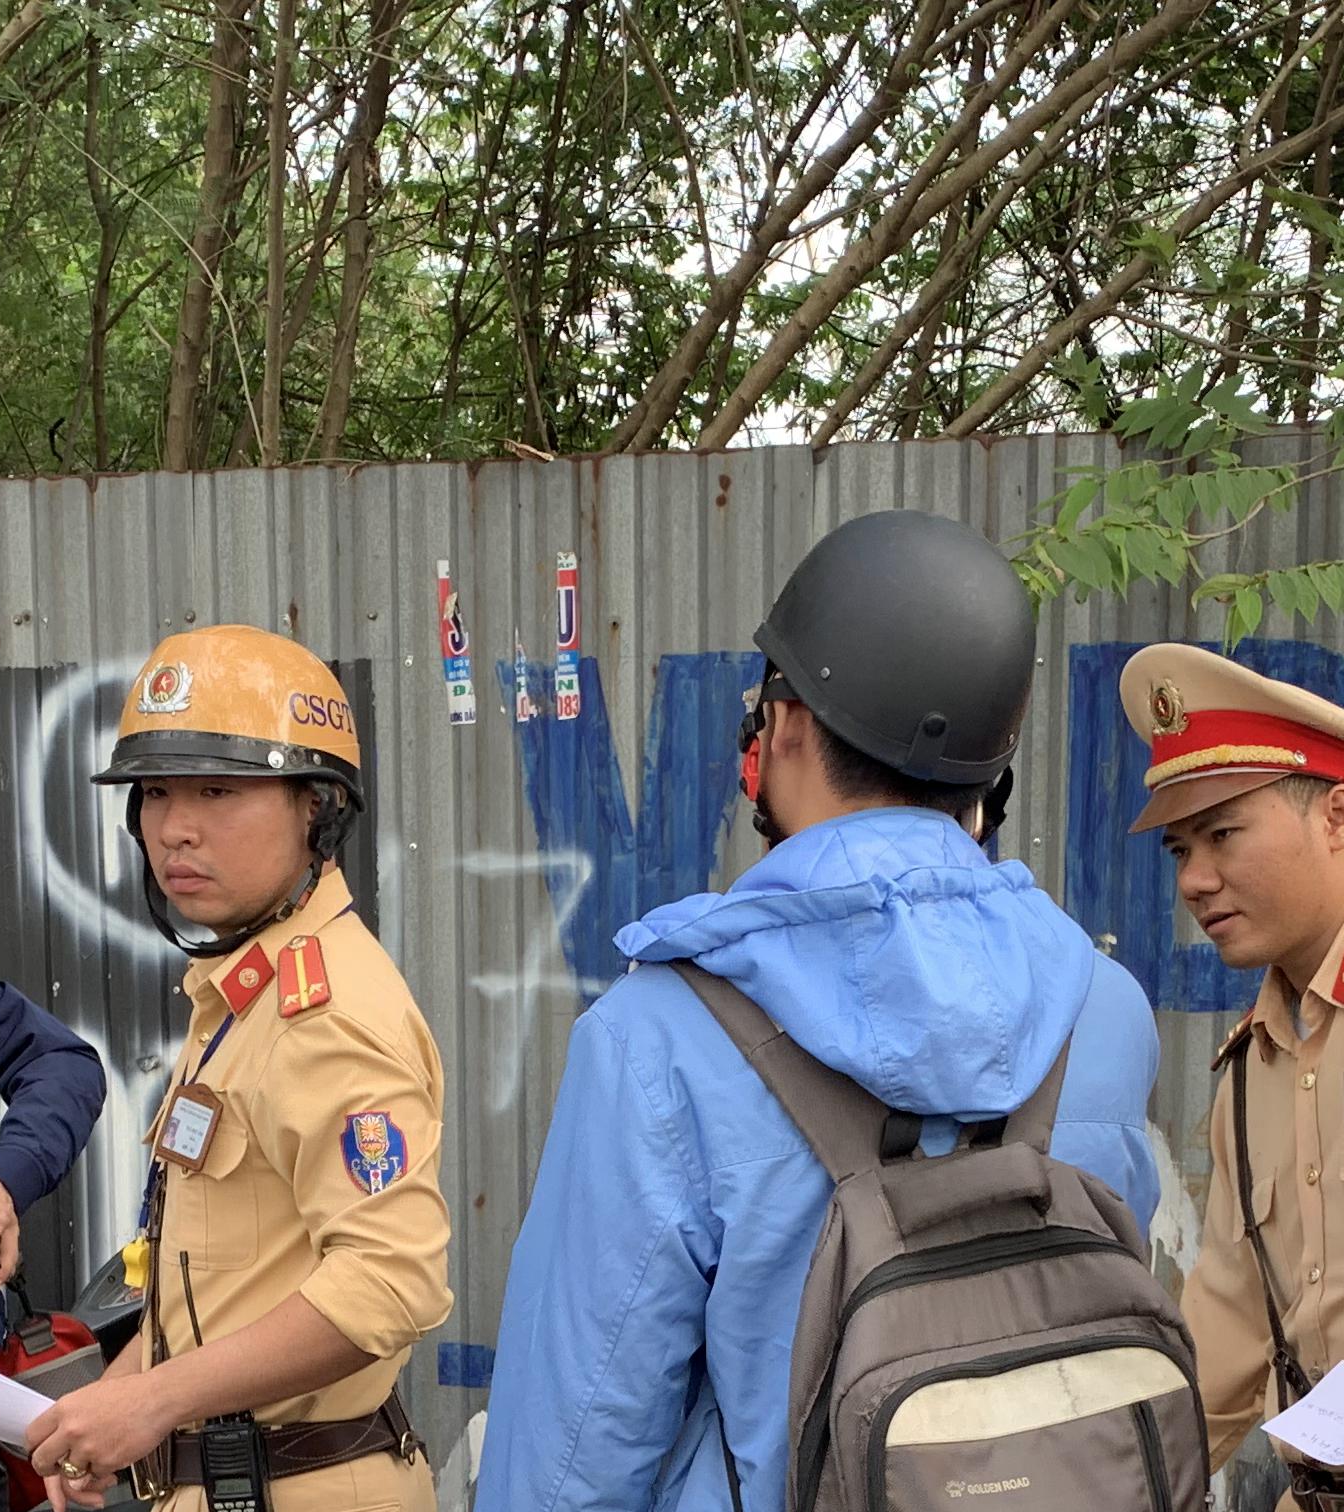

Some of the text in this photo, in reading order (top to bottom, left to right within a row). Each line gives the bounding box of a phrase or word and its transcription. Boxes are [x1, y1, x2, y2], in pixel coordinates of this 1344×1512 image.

[289, 692, 354, 734] CSGT
[351, 1156, 400, 1172] CSGT
[967, 1476, 1030, 1495] GOLDEN ROAD
